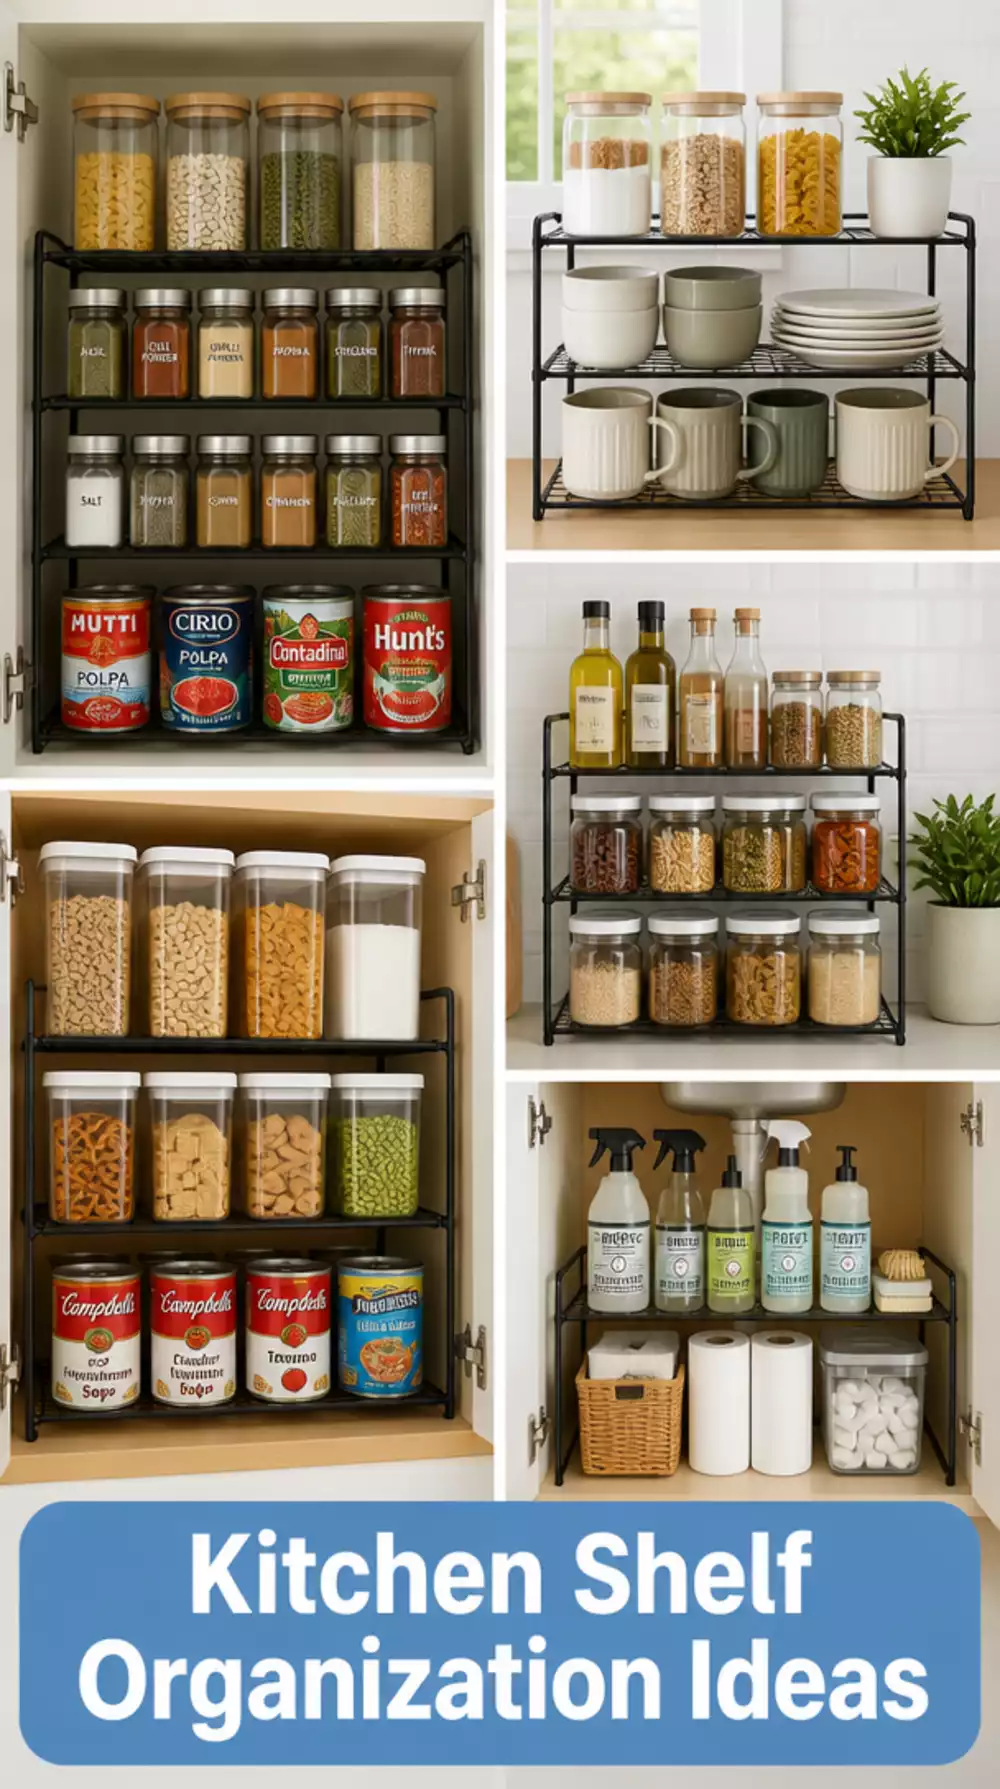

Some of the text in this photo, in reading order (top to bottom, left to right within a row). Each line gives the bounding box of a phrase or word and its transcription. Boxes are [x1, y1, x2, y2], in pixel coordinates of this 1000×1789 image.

[80, 496, 103, 506] SALT
[71, 614, 137, 633] MUTTI
[175, 613, 233, 632] CIRIO
[374, 623, 445, 651] Hunt's
[179, 650, 229, 665] POLPA
[77, 671, 130, 688] POLPA
